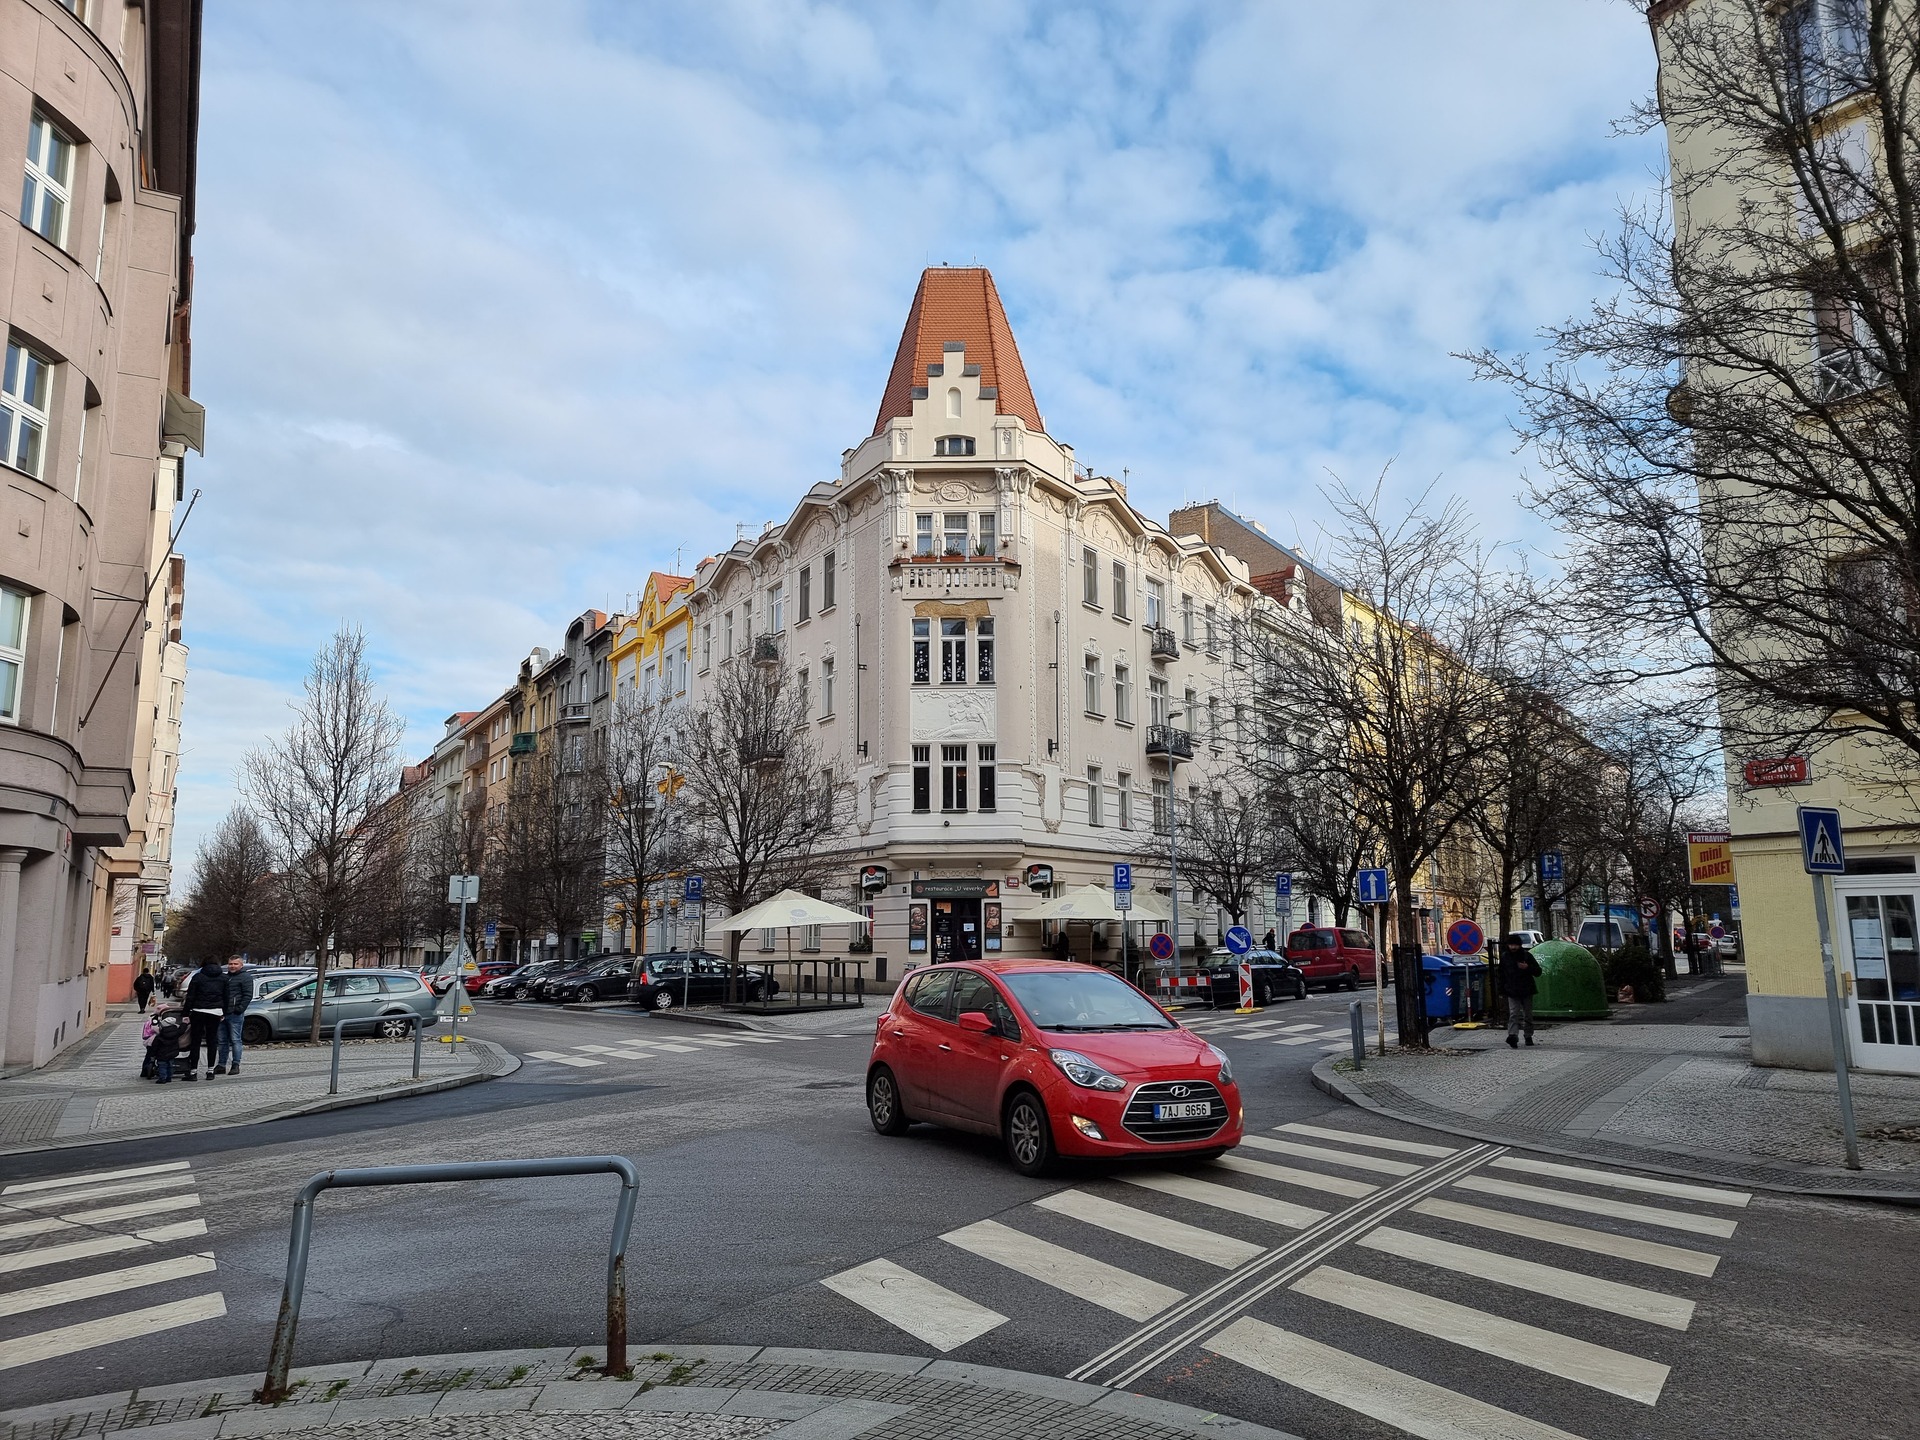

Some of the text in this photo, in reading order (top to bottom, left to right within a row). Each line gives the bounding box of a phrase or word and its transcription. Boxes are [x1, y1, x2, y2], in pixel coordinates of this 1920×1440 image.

[1692, 835, 1728, 843] POTRAVINY
[1700, 845, 1722, 863] mini
[1117, 867, 1127, 883] P
[1693, 860, 1731, 881] MARKET
[1161, 1103, 1207, 1118] 7AJ 9656
